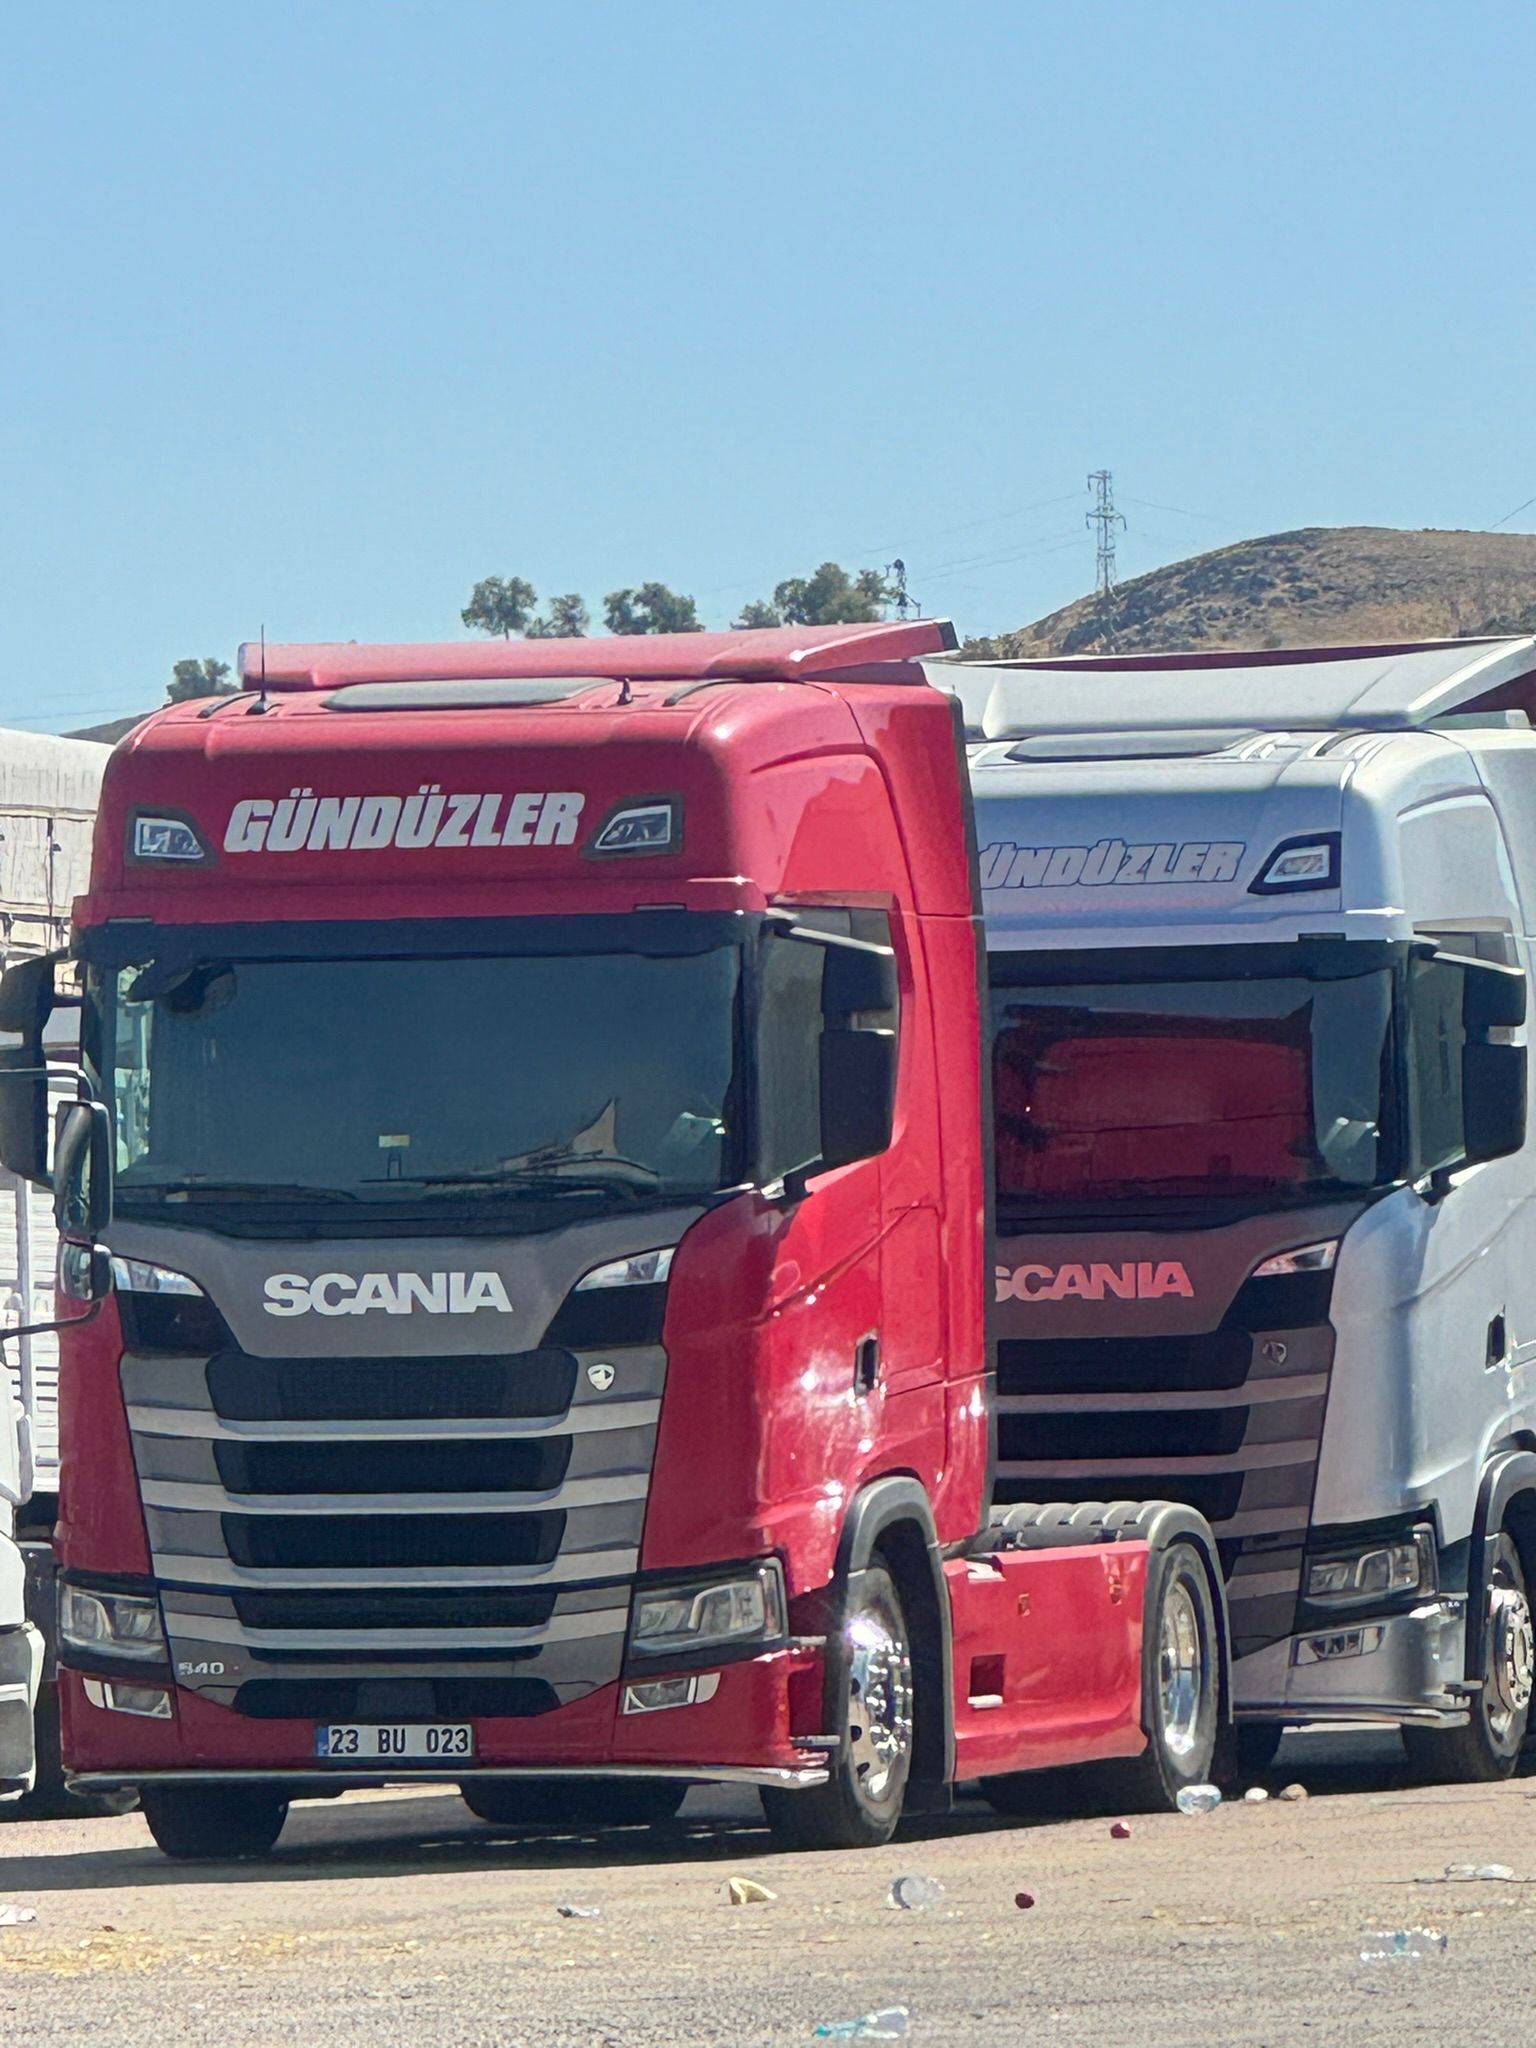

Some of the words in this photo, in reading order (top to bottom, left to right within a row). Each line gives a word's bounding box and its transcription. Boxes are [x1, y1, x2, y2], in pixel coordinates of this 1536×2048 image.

[223, 784, 585, 852] GÜNDÜZLER
[979, 838, 1246, 889] ÜNDÜZLER
[263, 1271, 513, 1316] SCANIA
[331, 1728, 359, 1754] 23
[378, 1728, 405, 1754] BU
[426, 1728, 468, 1754] 023
